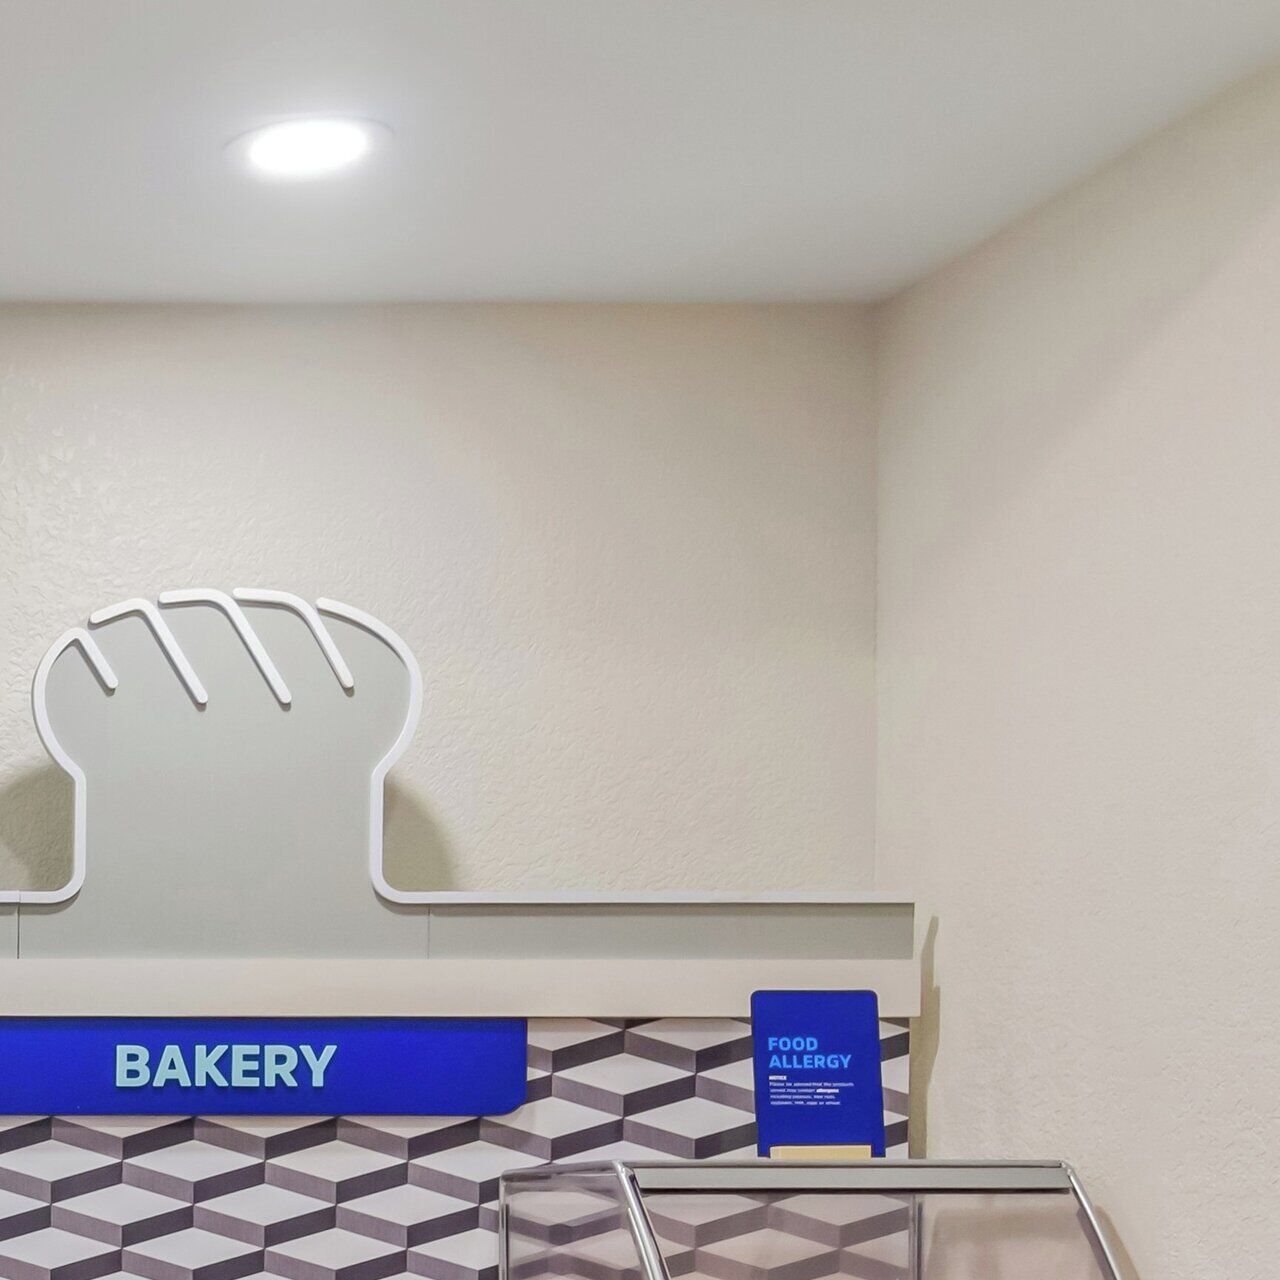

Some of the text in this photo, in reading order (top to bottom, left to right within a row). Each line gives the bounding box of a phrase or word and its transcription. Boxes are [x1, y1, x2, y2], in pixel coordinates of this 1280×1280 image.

[767, 1036, 819, 1052] FOOD
[115, 1044, 338, 1087] BAKERY
[768, 1054, 852, 1069] ALLERGY
